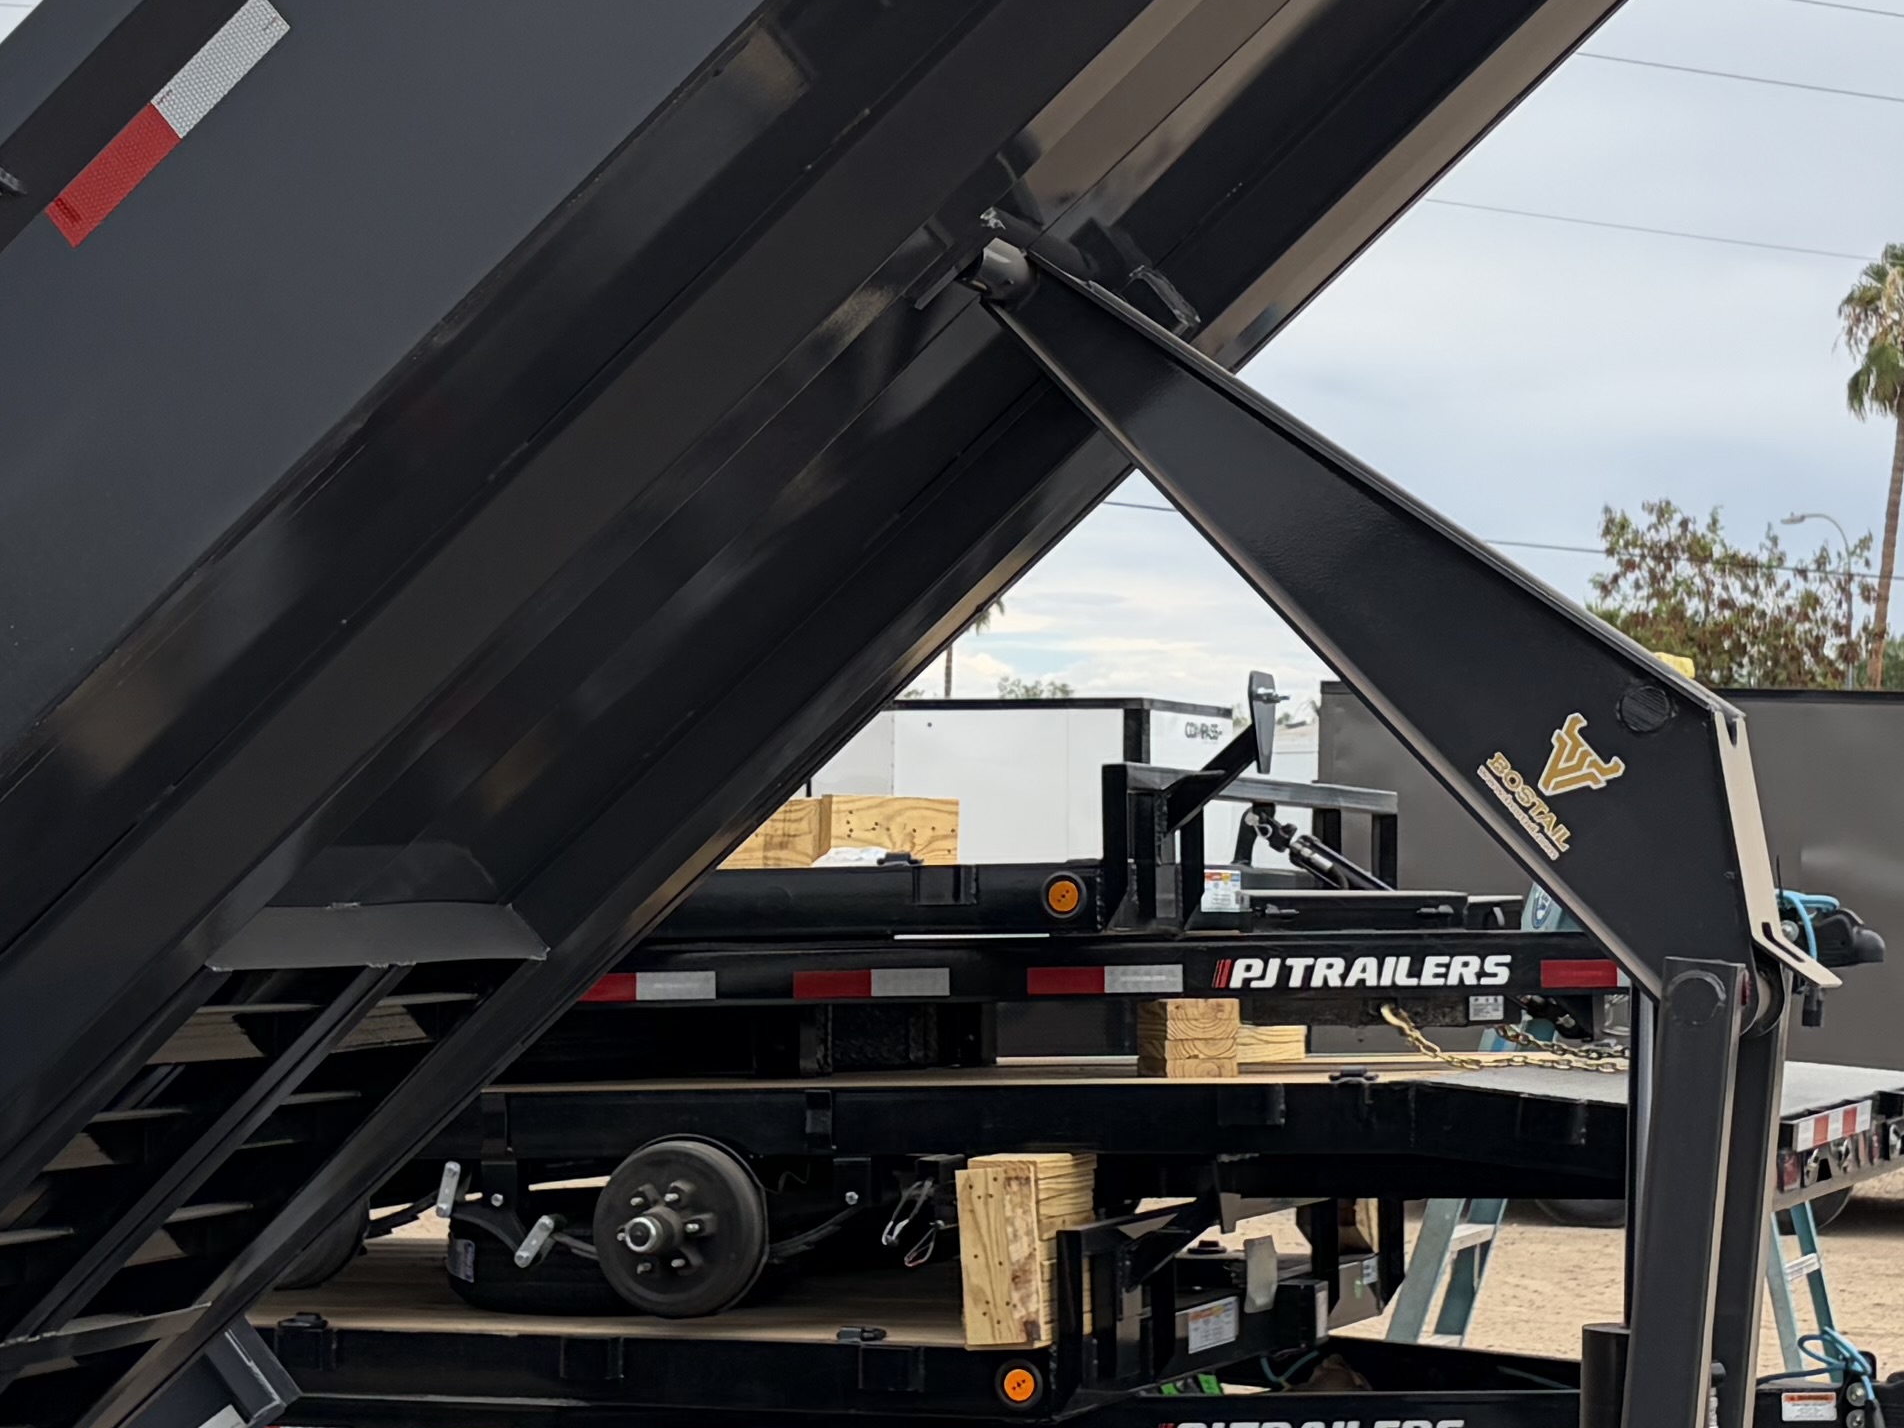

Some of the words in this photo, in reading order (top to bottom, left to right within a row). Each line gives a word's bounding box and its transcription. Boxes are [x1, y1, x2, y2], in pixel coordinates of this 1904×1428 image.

[1486, 751, 1571, 852] BOSTAIL
[1228, 958, 1282, 988] PJ
[1285, 954, 1512, 988] TRAILERS
